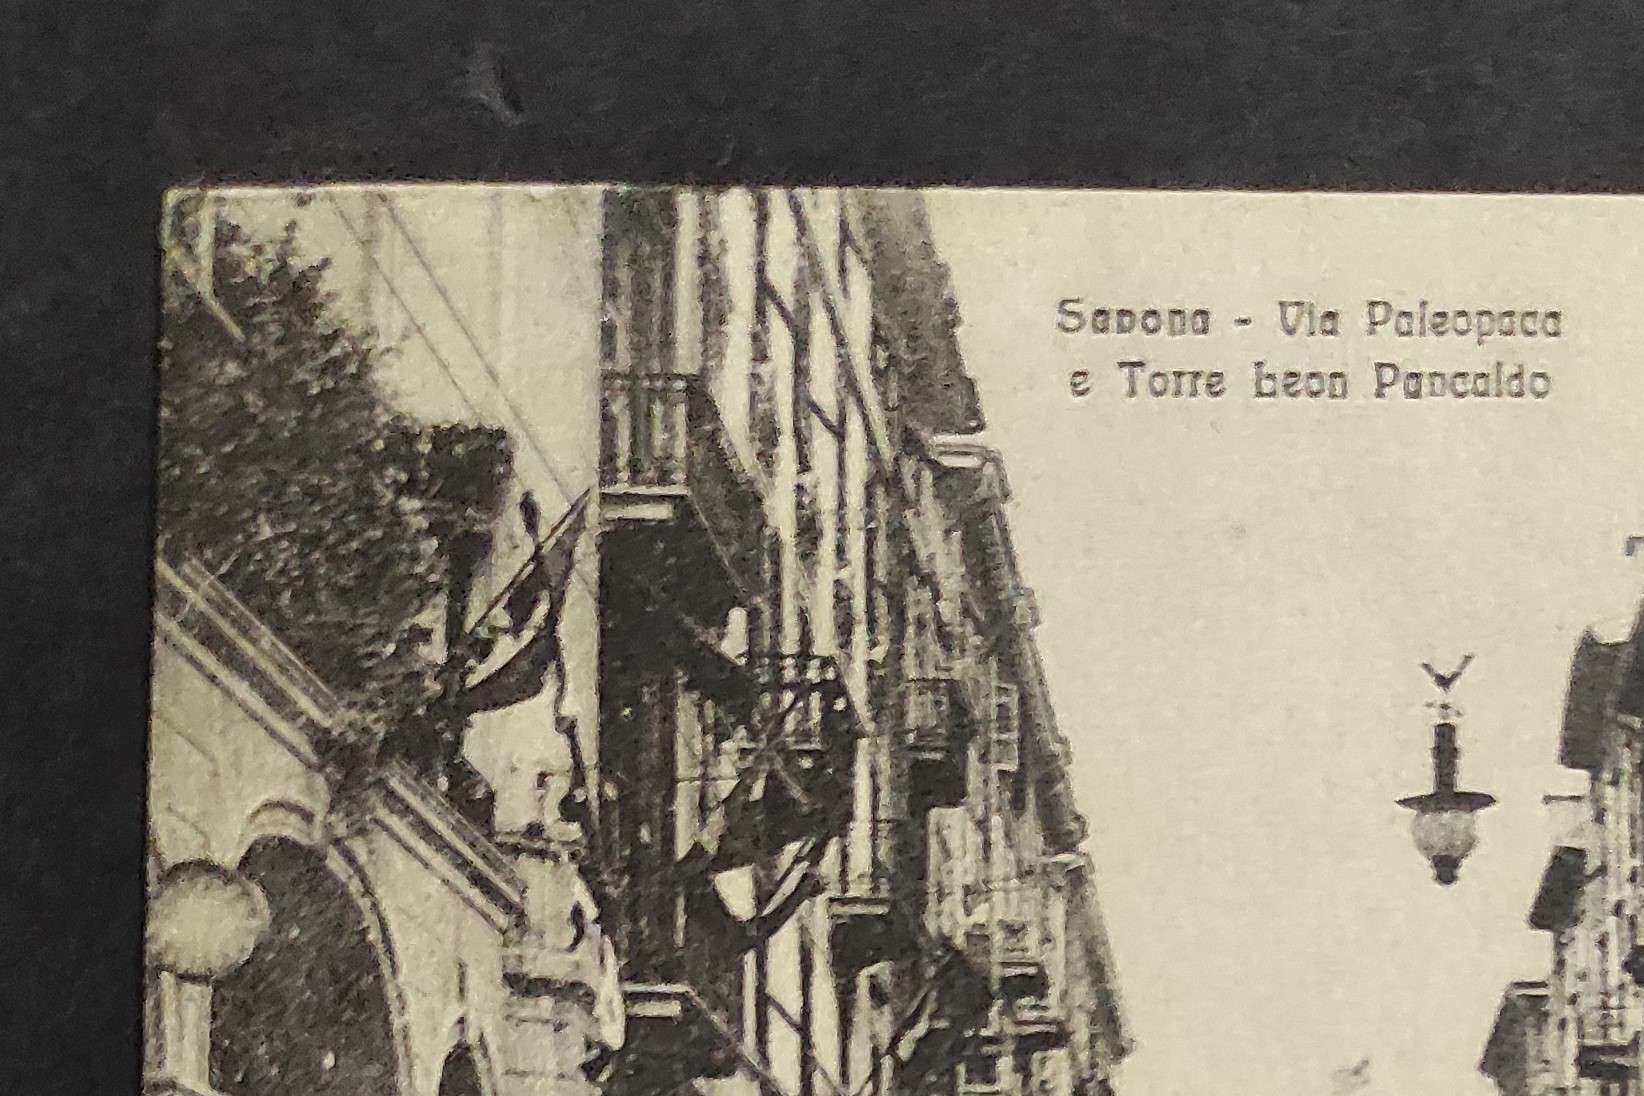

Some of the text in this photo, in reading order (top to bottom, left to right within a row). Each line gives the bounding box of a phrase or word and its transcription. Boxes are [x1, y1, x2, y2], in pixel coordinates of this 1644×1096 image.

[1056, 299, 1211, 335] Savona
[1277, 300, 1340, 336] Via
[1068, 370, 1091, 397] e
[1115, 360, 1226, 398] Torre
[1373, 360, 1552, 398] Pancaldo
